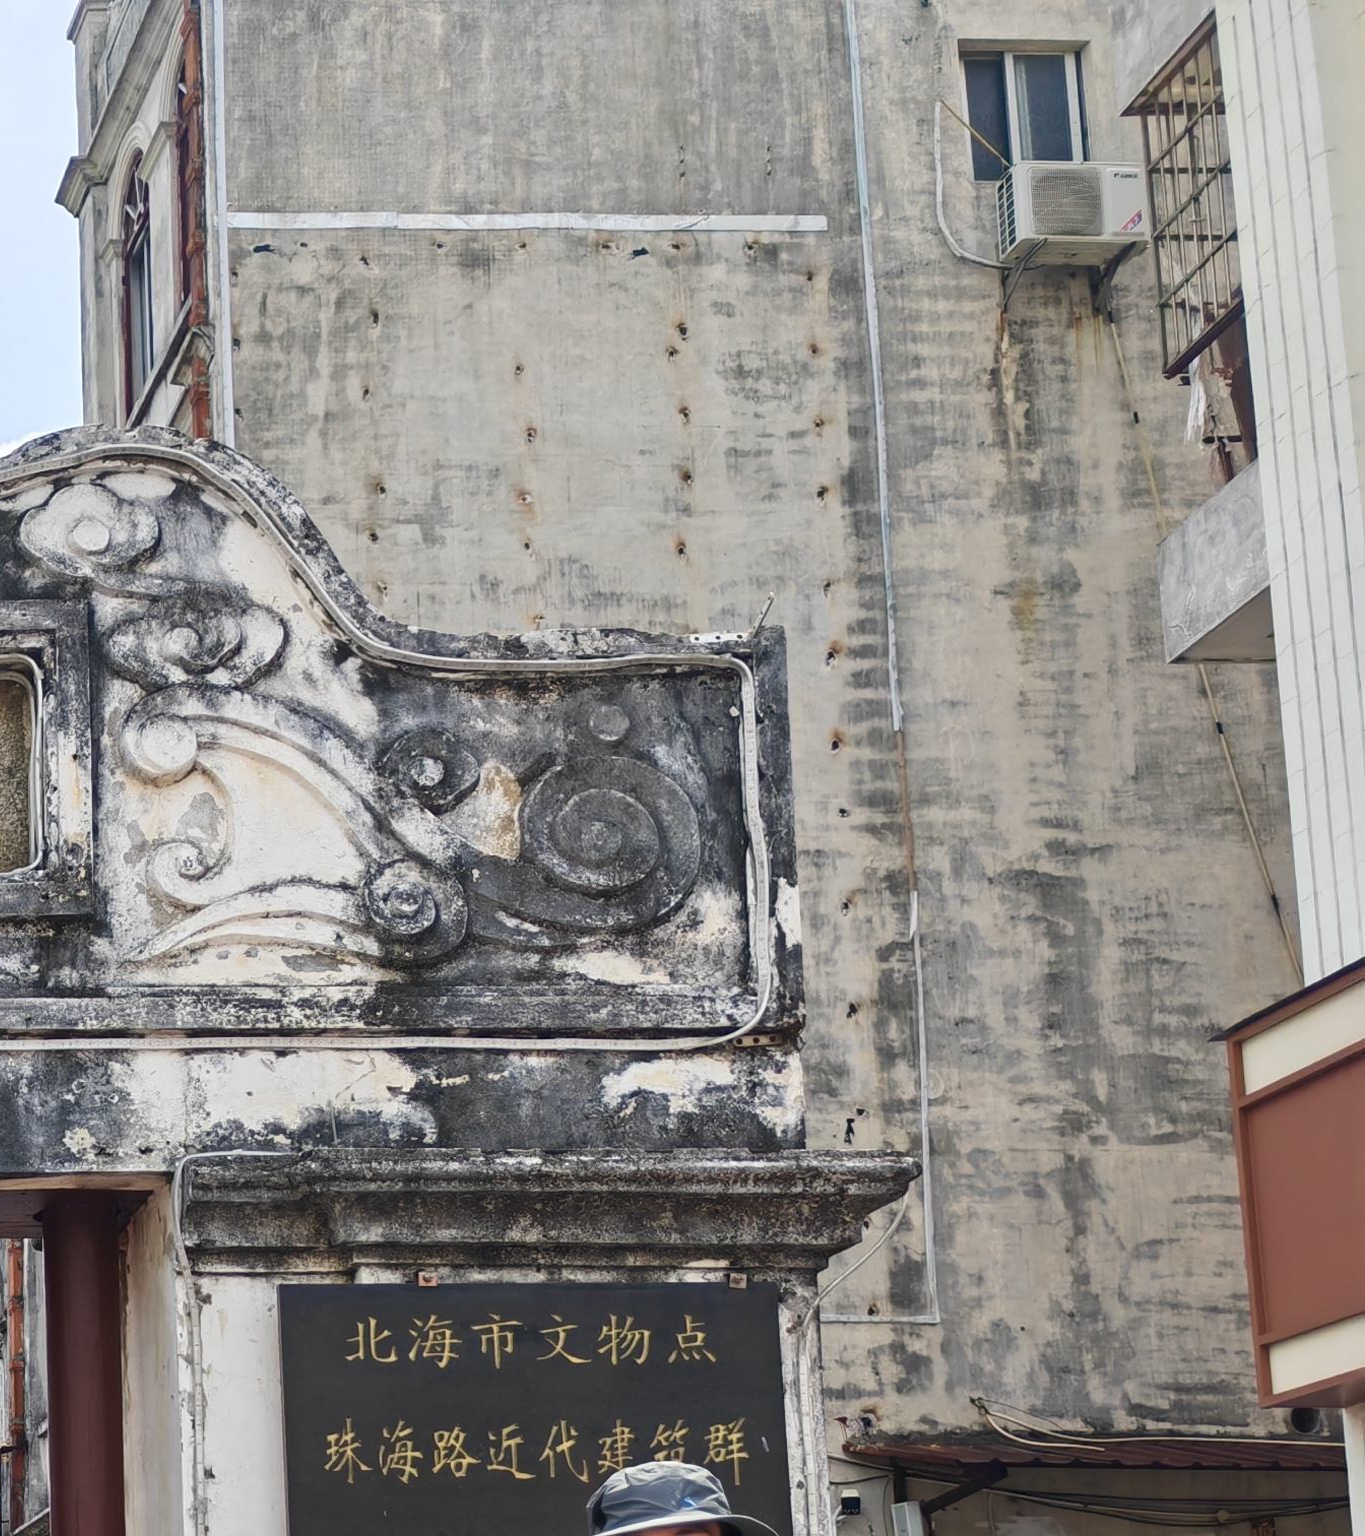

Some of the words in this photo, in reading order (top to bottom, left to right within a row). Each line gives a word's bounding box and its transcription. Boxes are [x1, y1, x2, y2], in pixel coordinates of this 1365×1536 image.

[345, 1313, 717, 1370] 北海市文物点
[324, 1416, 750, 1486] 珠海路近代建筑群
